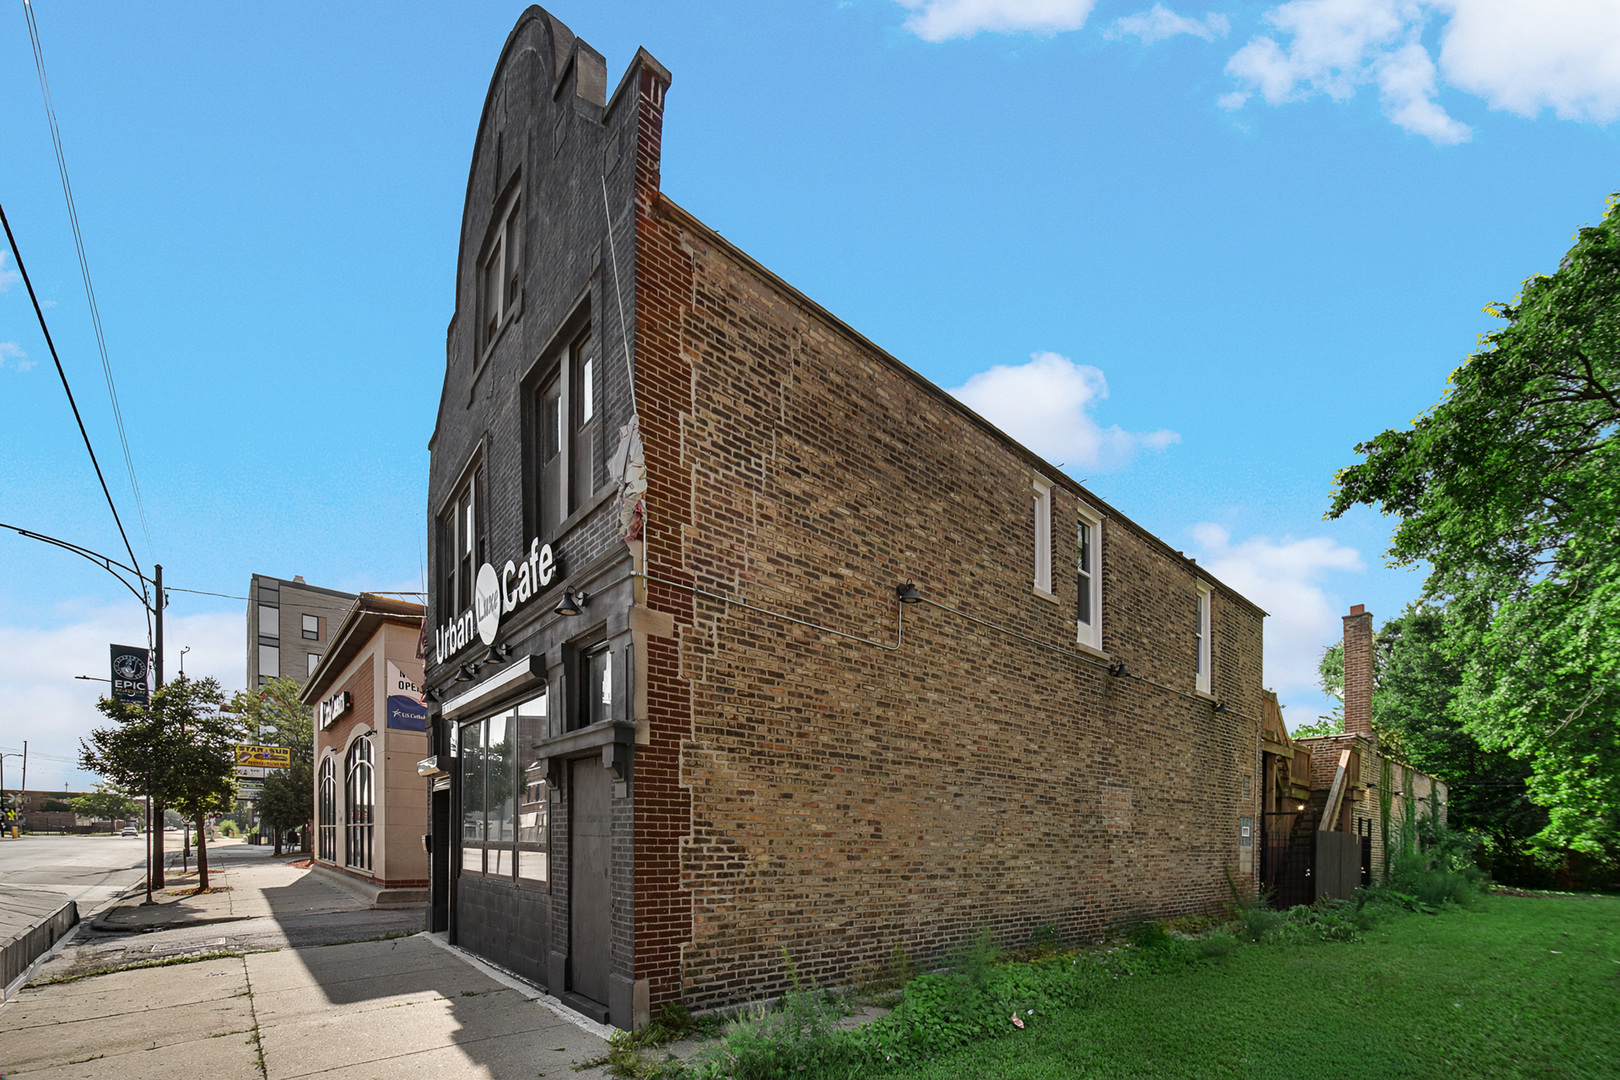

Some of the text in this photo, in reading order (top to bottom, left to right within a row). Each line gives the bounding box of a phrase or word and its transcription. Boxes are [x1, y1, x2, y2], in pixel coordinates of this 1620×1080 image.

[436, 537, 555, 665] Urban Luxe Cafe
[114, 679, 146, 691] EPIC
[238, 745, 264, 753] STAR
